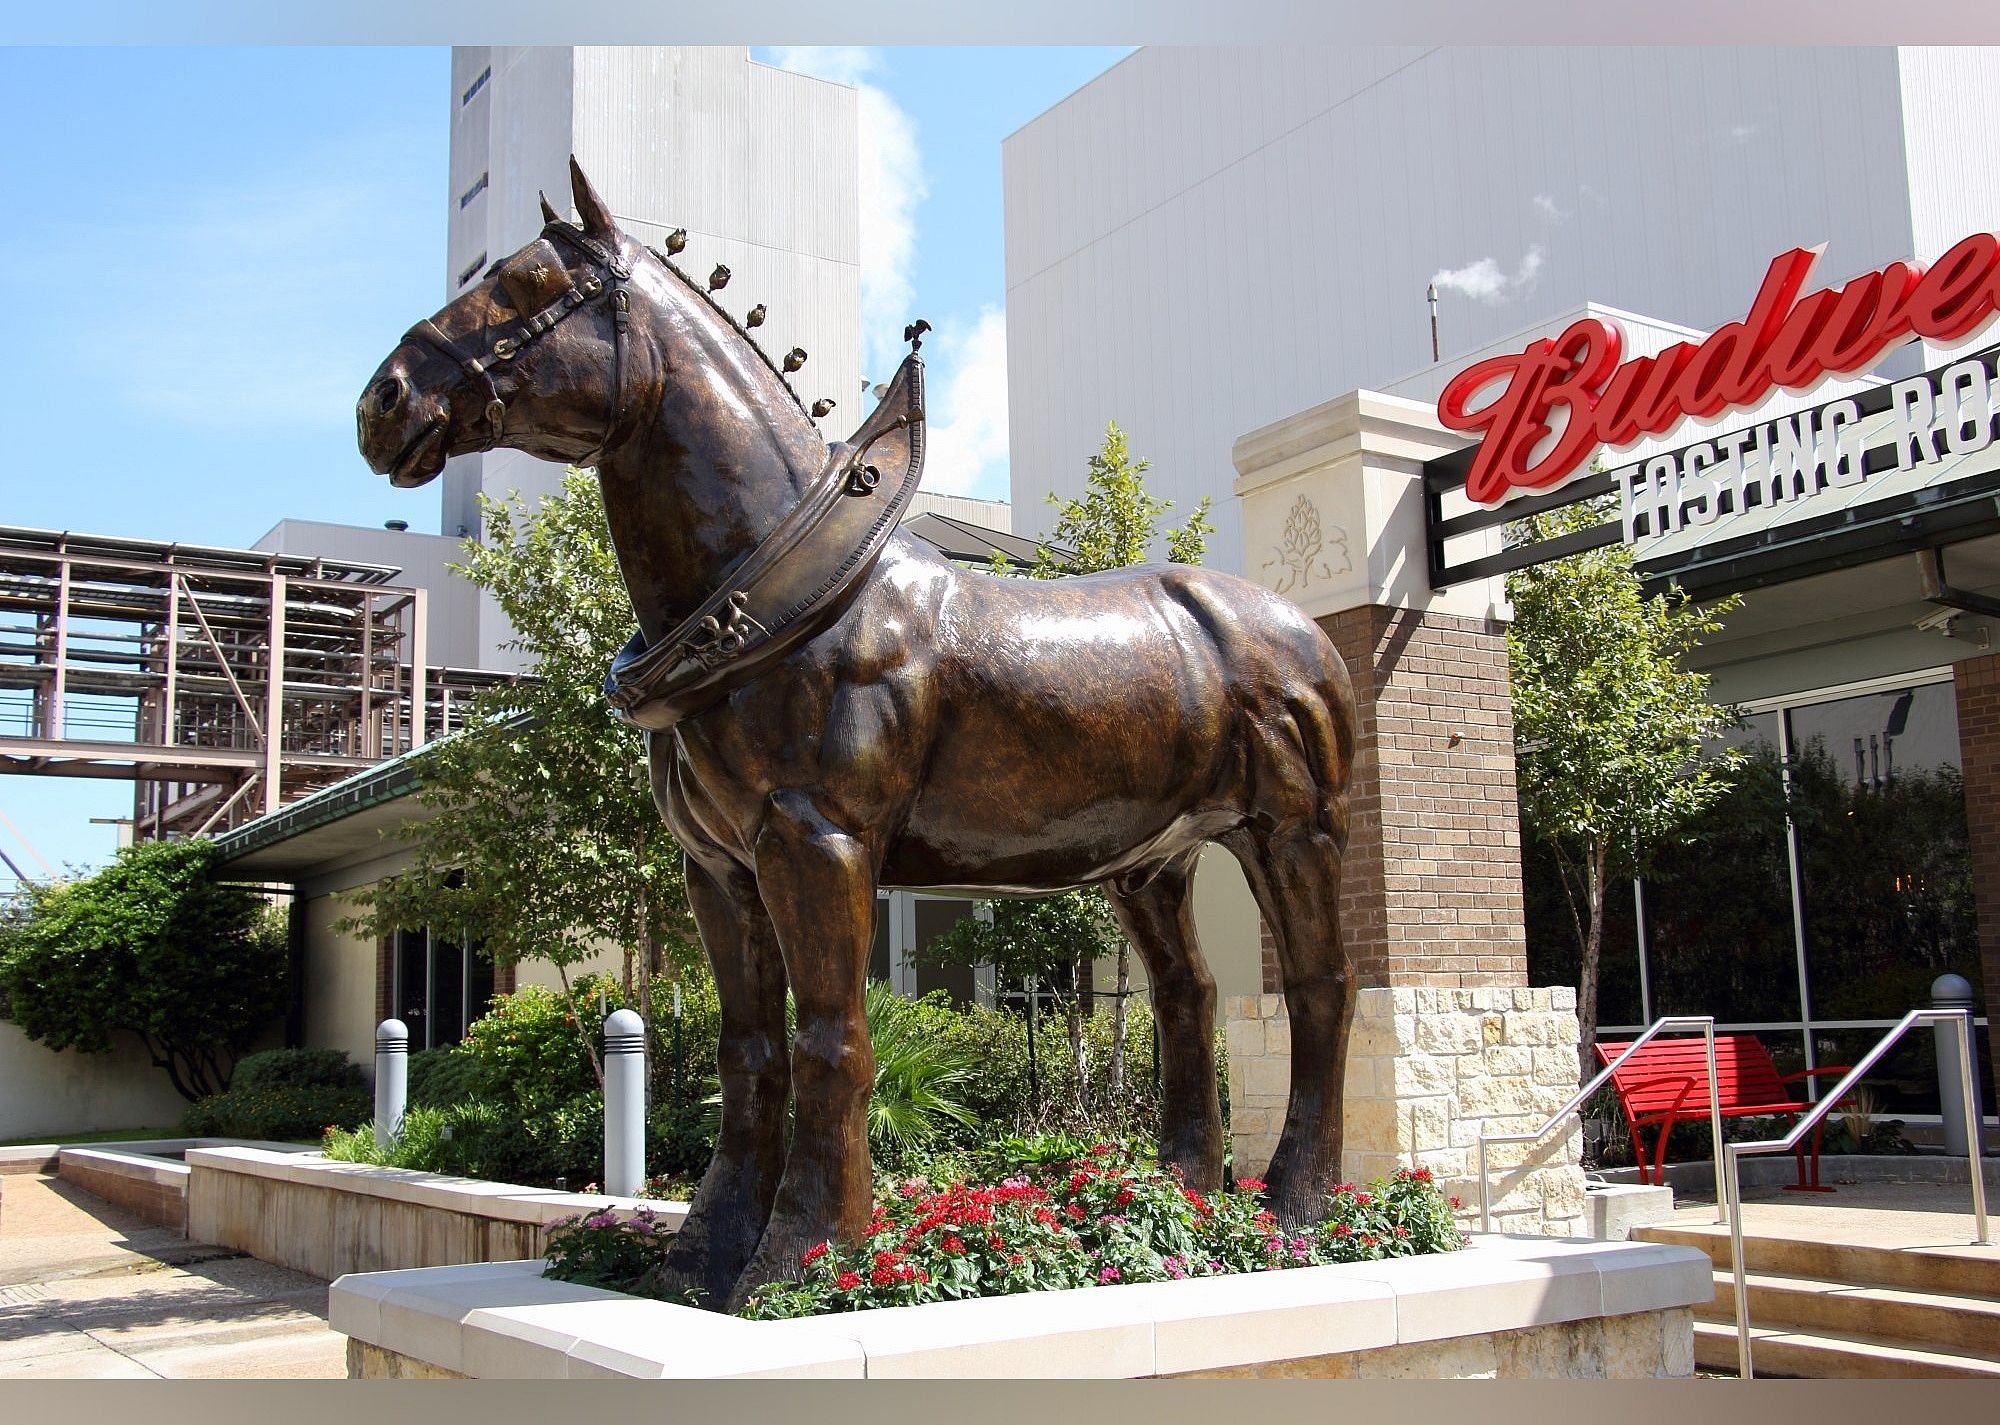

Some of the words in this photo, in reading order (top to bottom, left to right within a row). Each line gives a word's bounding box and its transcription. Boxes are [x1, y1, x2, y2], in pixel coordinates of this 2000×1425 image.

[1437, 232, 2000, 504] Budwe
[1610, 398, 1868, 545] TASTING
[1891, 357, 2000, 471] RO
